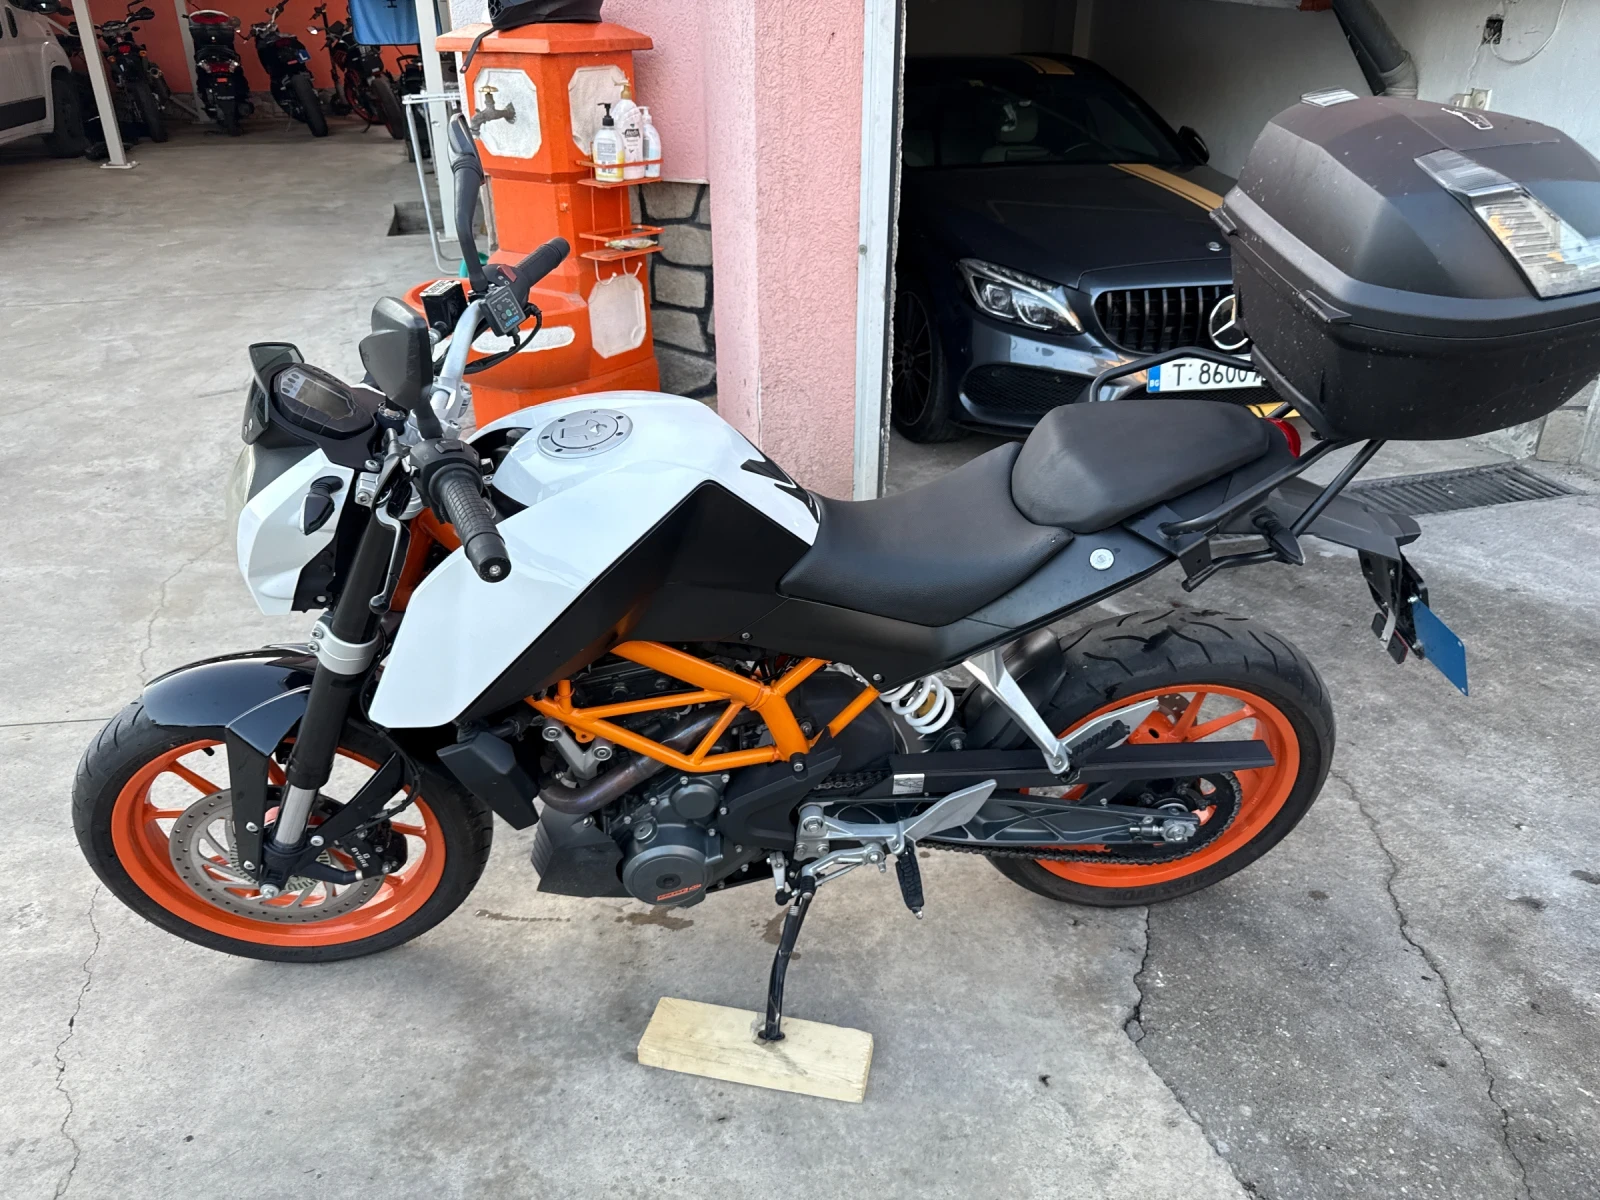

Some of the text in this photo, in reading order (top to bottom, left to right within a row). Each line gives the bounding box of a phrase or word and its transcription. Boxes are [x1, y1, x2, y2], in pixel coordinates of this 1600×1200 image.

[1150, 379, 1160, 387] BG
[1172, 363, 1186, 386] T
[351, 847, 369, 868] BYBRE
